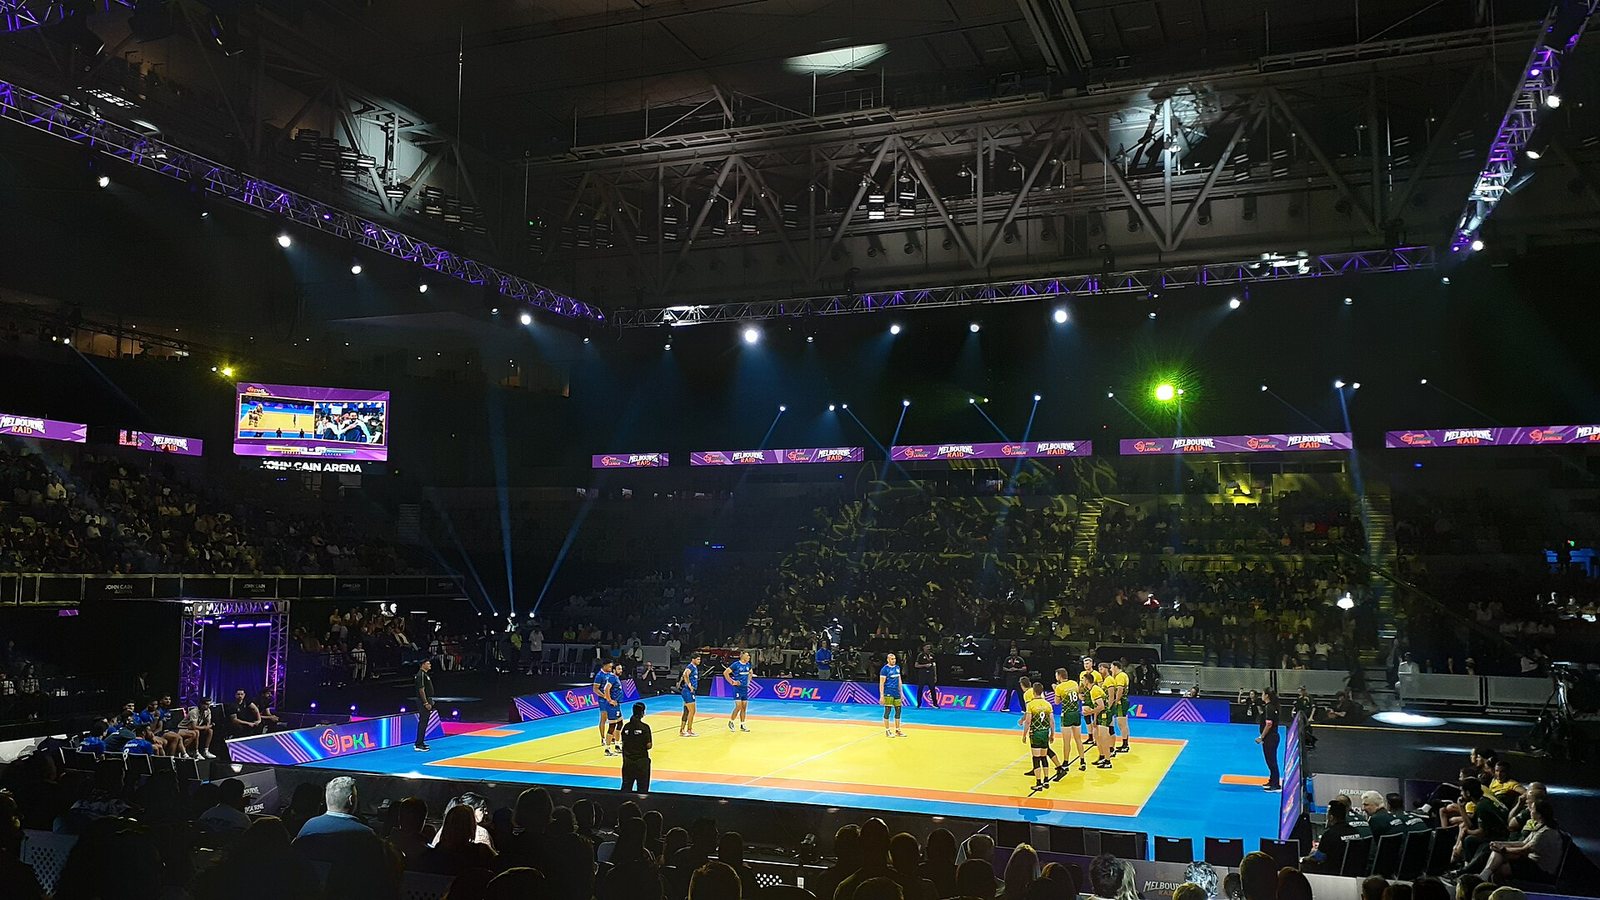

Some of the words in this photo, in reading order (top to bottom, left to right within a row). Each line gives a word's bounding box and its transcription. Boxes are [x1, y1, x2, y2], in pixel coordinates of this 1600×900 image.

[11, 426, 33, 434] RAID
[1286, 435, 1333, 447] MELBOURNE
[1443, 430, 1494, 442] MELBOURNE
[1036, 442, 1077, 453] MELBOURNE
[1172, 438, 1216, 450] MELBOURNE
[731, 451, 765, 461] MELBOURNE
[817, 449, 852, 459] MELBOURNE
[937, 445, 974, 456] MELBOURNE
[628, 455, 659, 464] MELBOURNE
[323, 463, 362, 473] ARENA
[790, 686, 821, 699] PKL
[1068, 692, 1078, 703] 18
[578, 693, 599, 708] PKL
[941, 694, 976, 708] PKL
[1039, 711, 1045, 722] 9
[340, 732, 376, 752] PKL
